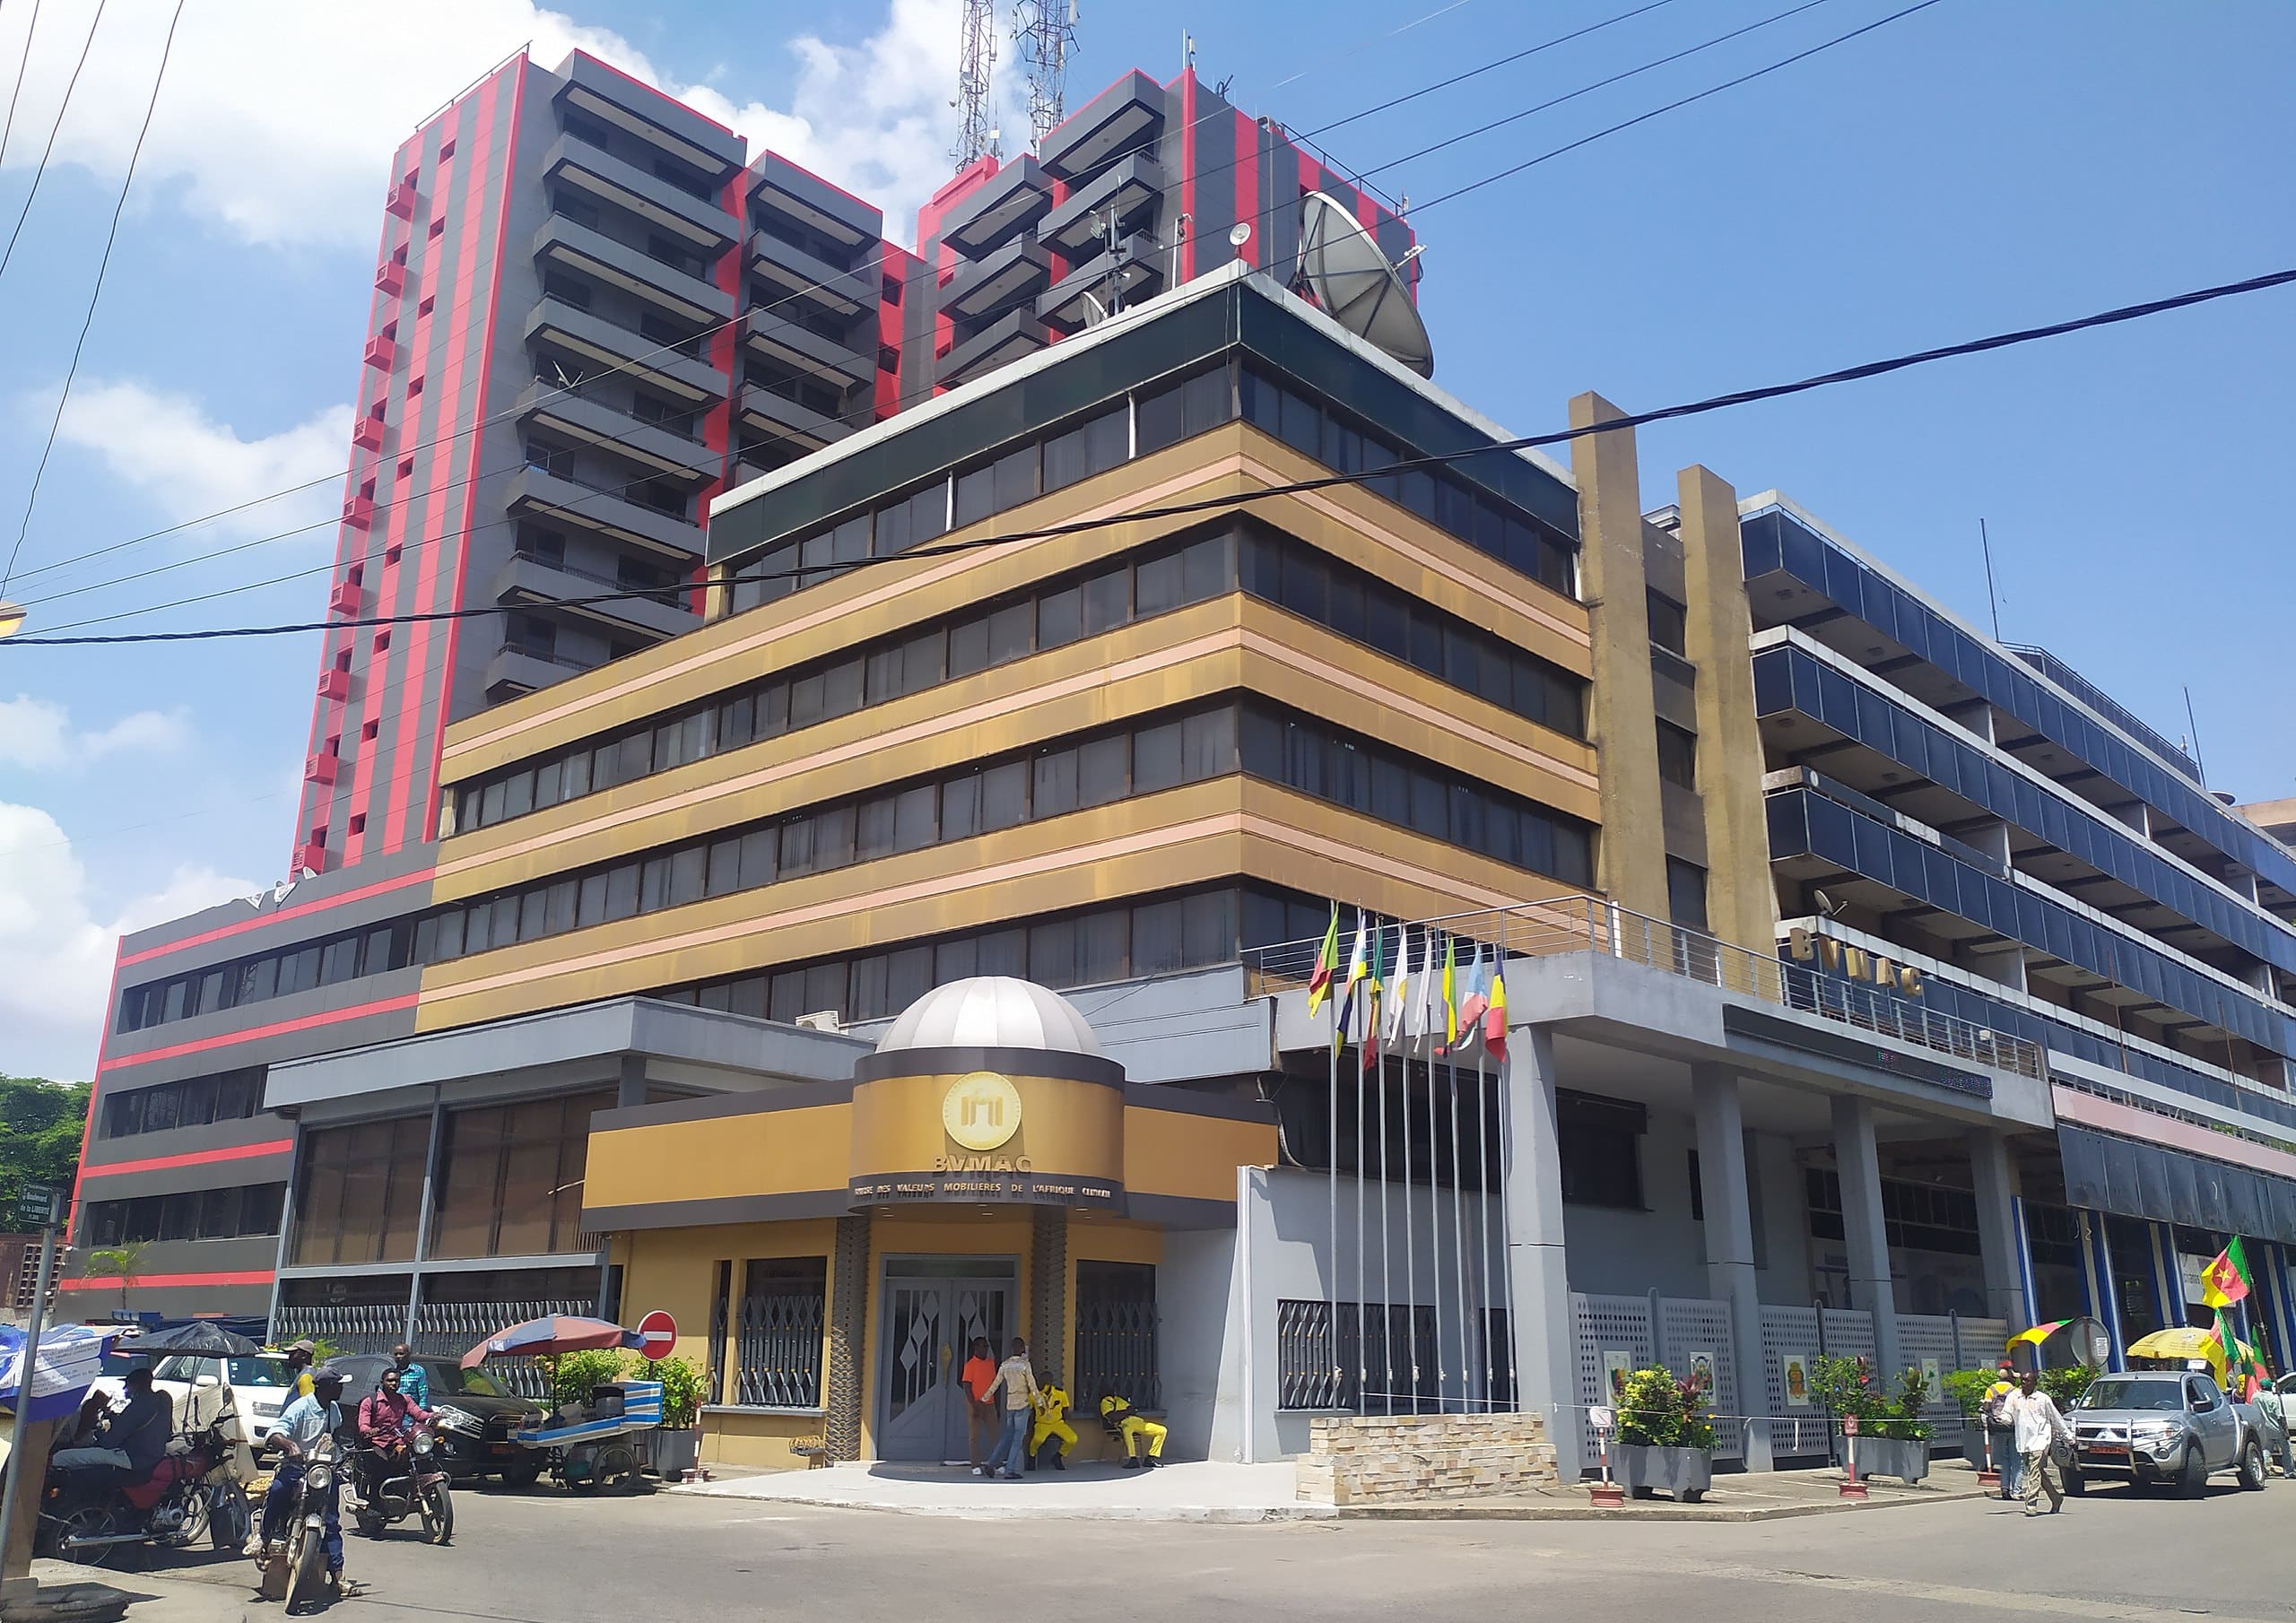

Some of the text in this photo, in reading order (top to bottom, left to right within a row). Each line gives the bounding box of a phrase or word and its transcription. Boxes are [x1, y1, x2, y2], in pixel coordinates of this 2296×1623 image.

[1789, 926, 1922, 997] BVMAC
[932, 1154, 1031, 1173] BVMAC
[876, 1185, 891, 1193] DES
[897, 1183, 935, 1193] VALEURS
[944, 1182, 1002, 1193] MOBILIERES
[1011, 1184, 1023, 1193] DE
[1032, 1184, 1075, 1195] L'AFRIQUE
